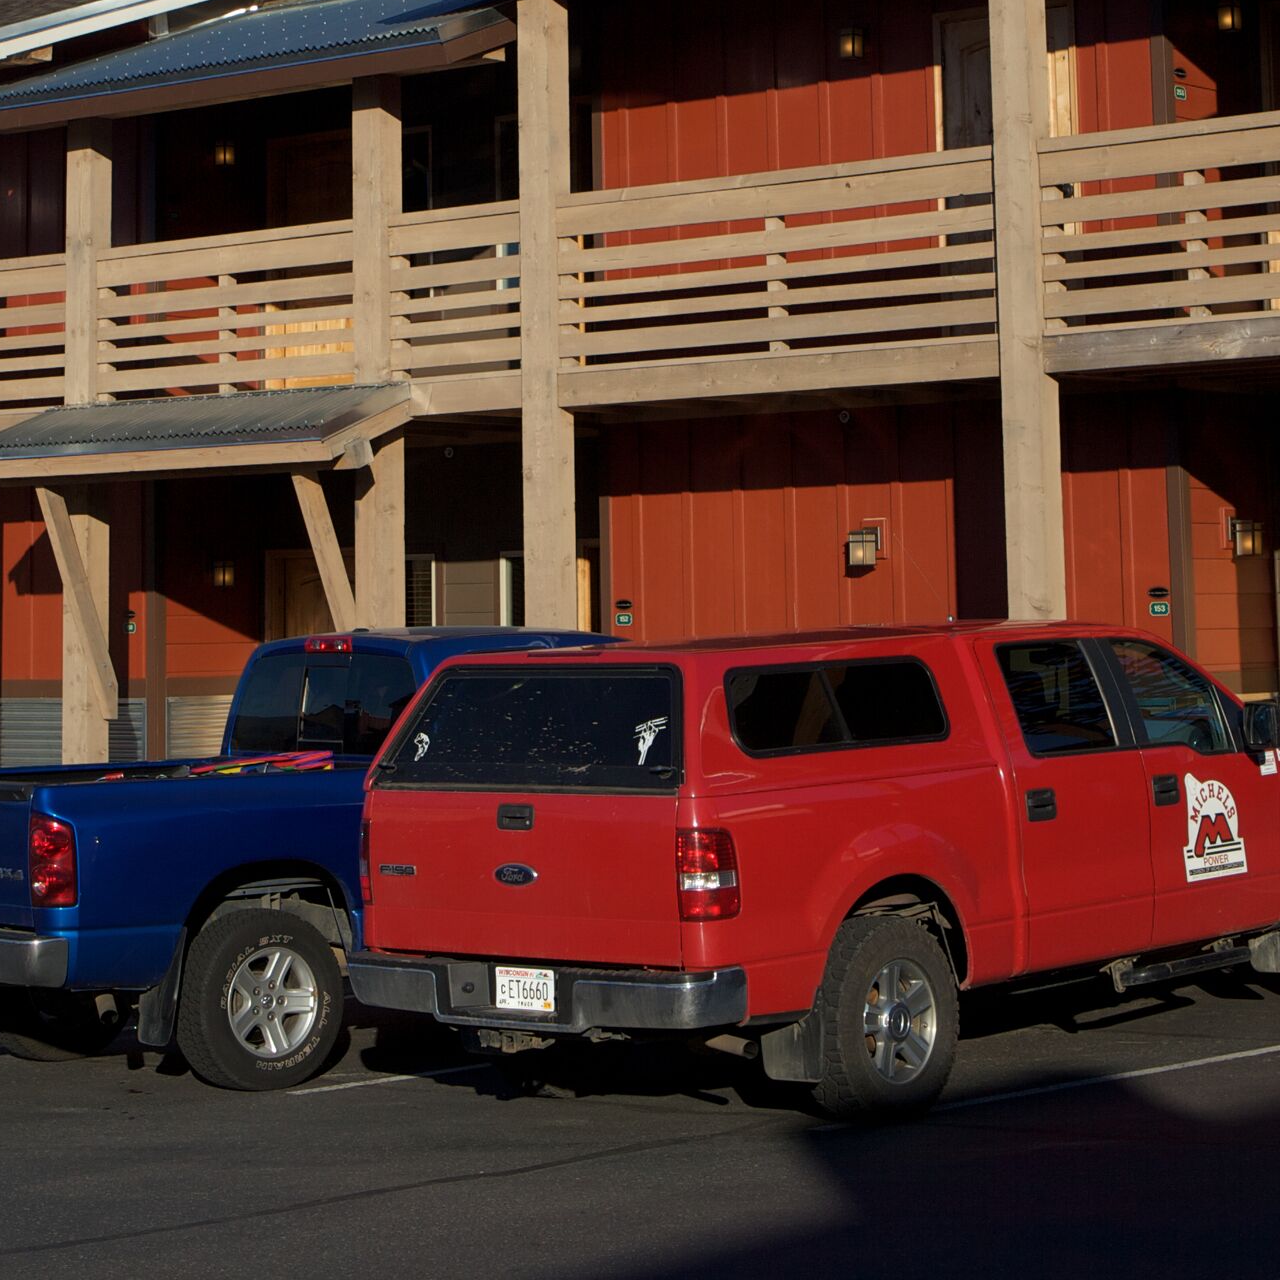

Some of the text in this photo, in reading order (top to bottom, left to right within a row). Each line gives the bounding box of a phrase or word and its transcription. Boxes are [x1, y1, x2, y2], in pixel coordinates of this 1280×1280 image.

[1190, 783, 1235, 824] MICHELS
[1194, 812, 1235, 858] M
[500, 867, 525, 882] Ford
[1203, 854, 1229, 866] POWER
[220, 946, 255, 1009] RADIAL
[498, 969, 528, 977] WISCONSIN
[256, 991, 331, 1070] ALL TERRAIN
